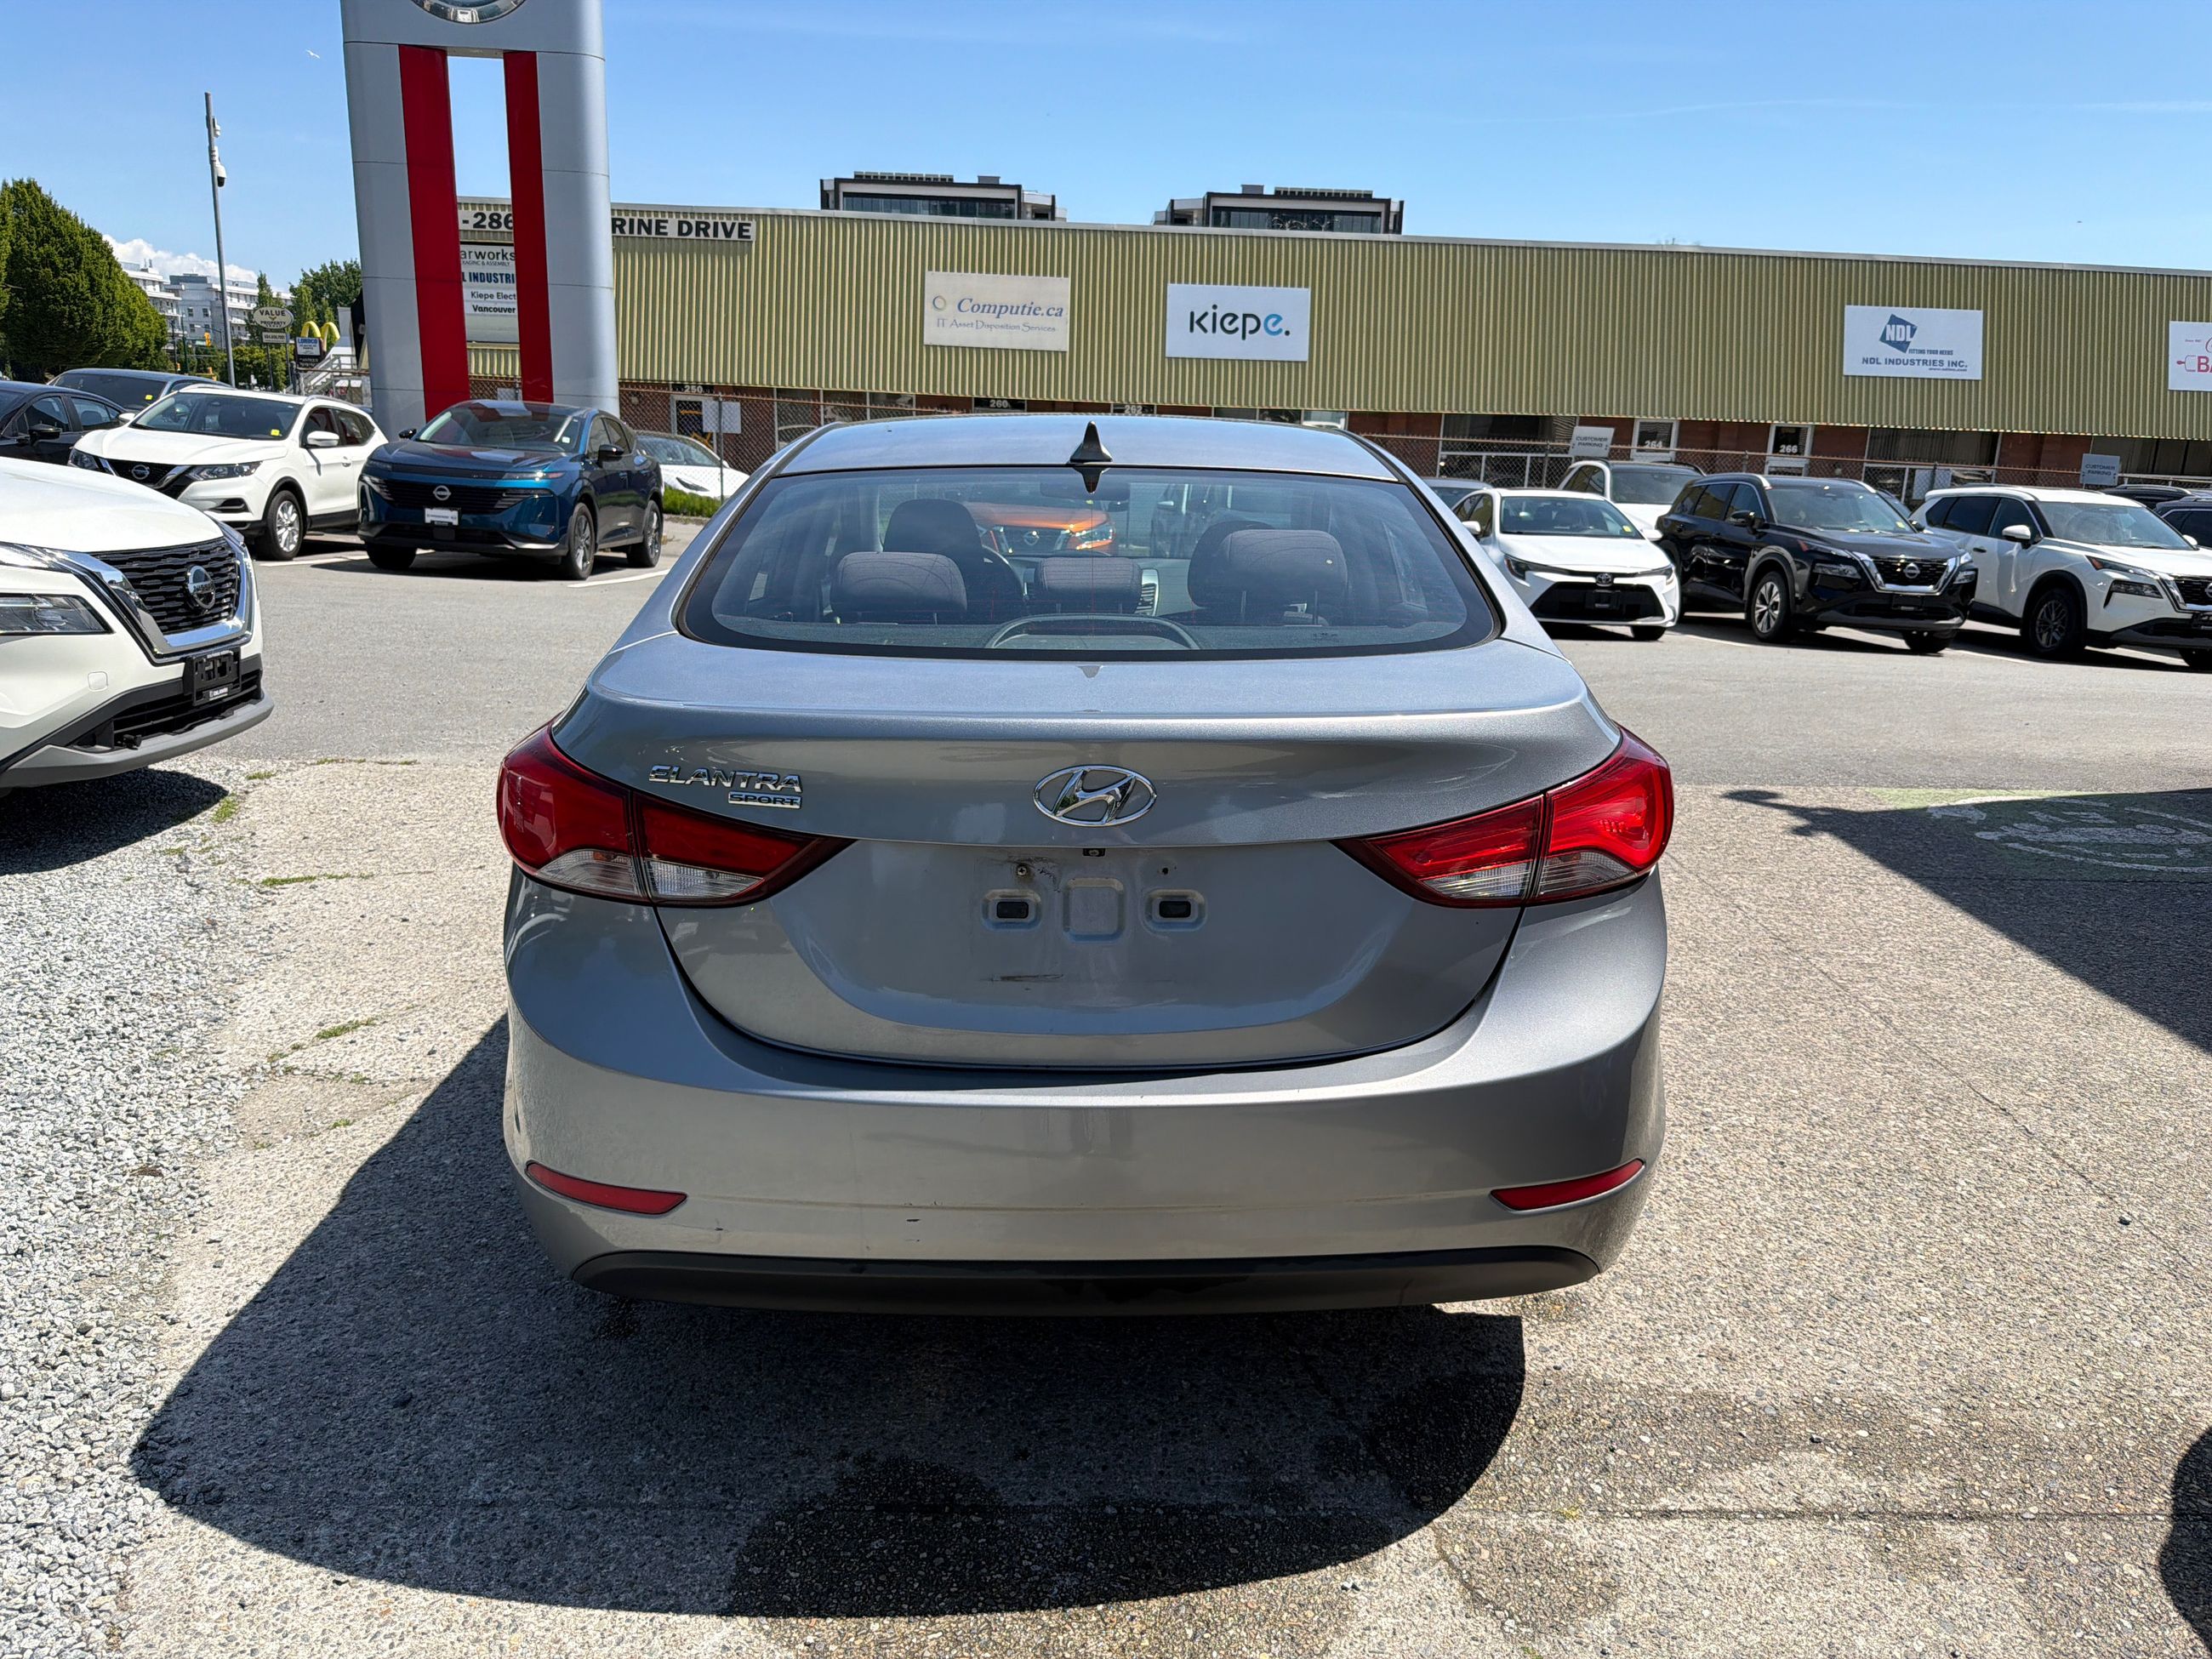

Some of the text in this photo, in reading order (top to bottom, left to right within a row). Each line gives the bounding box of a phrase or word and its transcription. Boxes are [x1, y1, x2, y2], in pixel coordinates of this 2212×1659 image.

[611, 217, 752, 239] RINE DRIVE
[469, 271, 516, 284] INDUSTRI
[470, 291, 495, 300] Kiepe
[472, 305, 516, 313] Vancouver
[957, 298, 1064, 319] Computie.ca
[937, 318, 1057, 332] IT Asset Disposition Services
[1885, 324, 1915, 342] NDL
[1861, 356, 1969, 368] NDL INDUSTRIES INC.
[683, 385, 704, 394] 250
[989, 399, 1009, 408] 260
[1124, 404, 1143, 415] 262
[1779, 444, 1799, 453] 266
[648, 765, 803, 793] ELANTRA
[729, 793, 799, 807] SPORT
